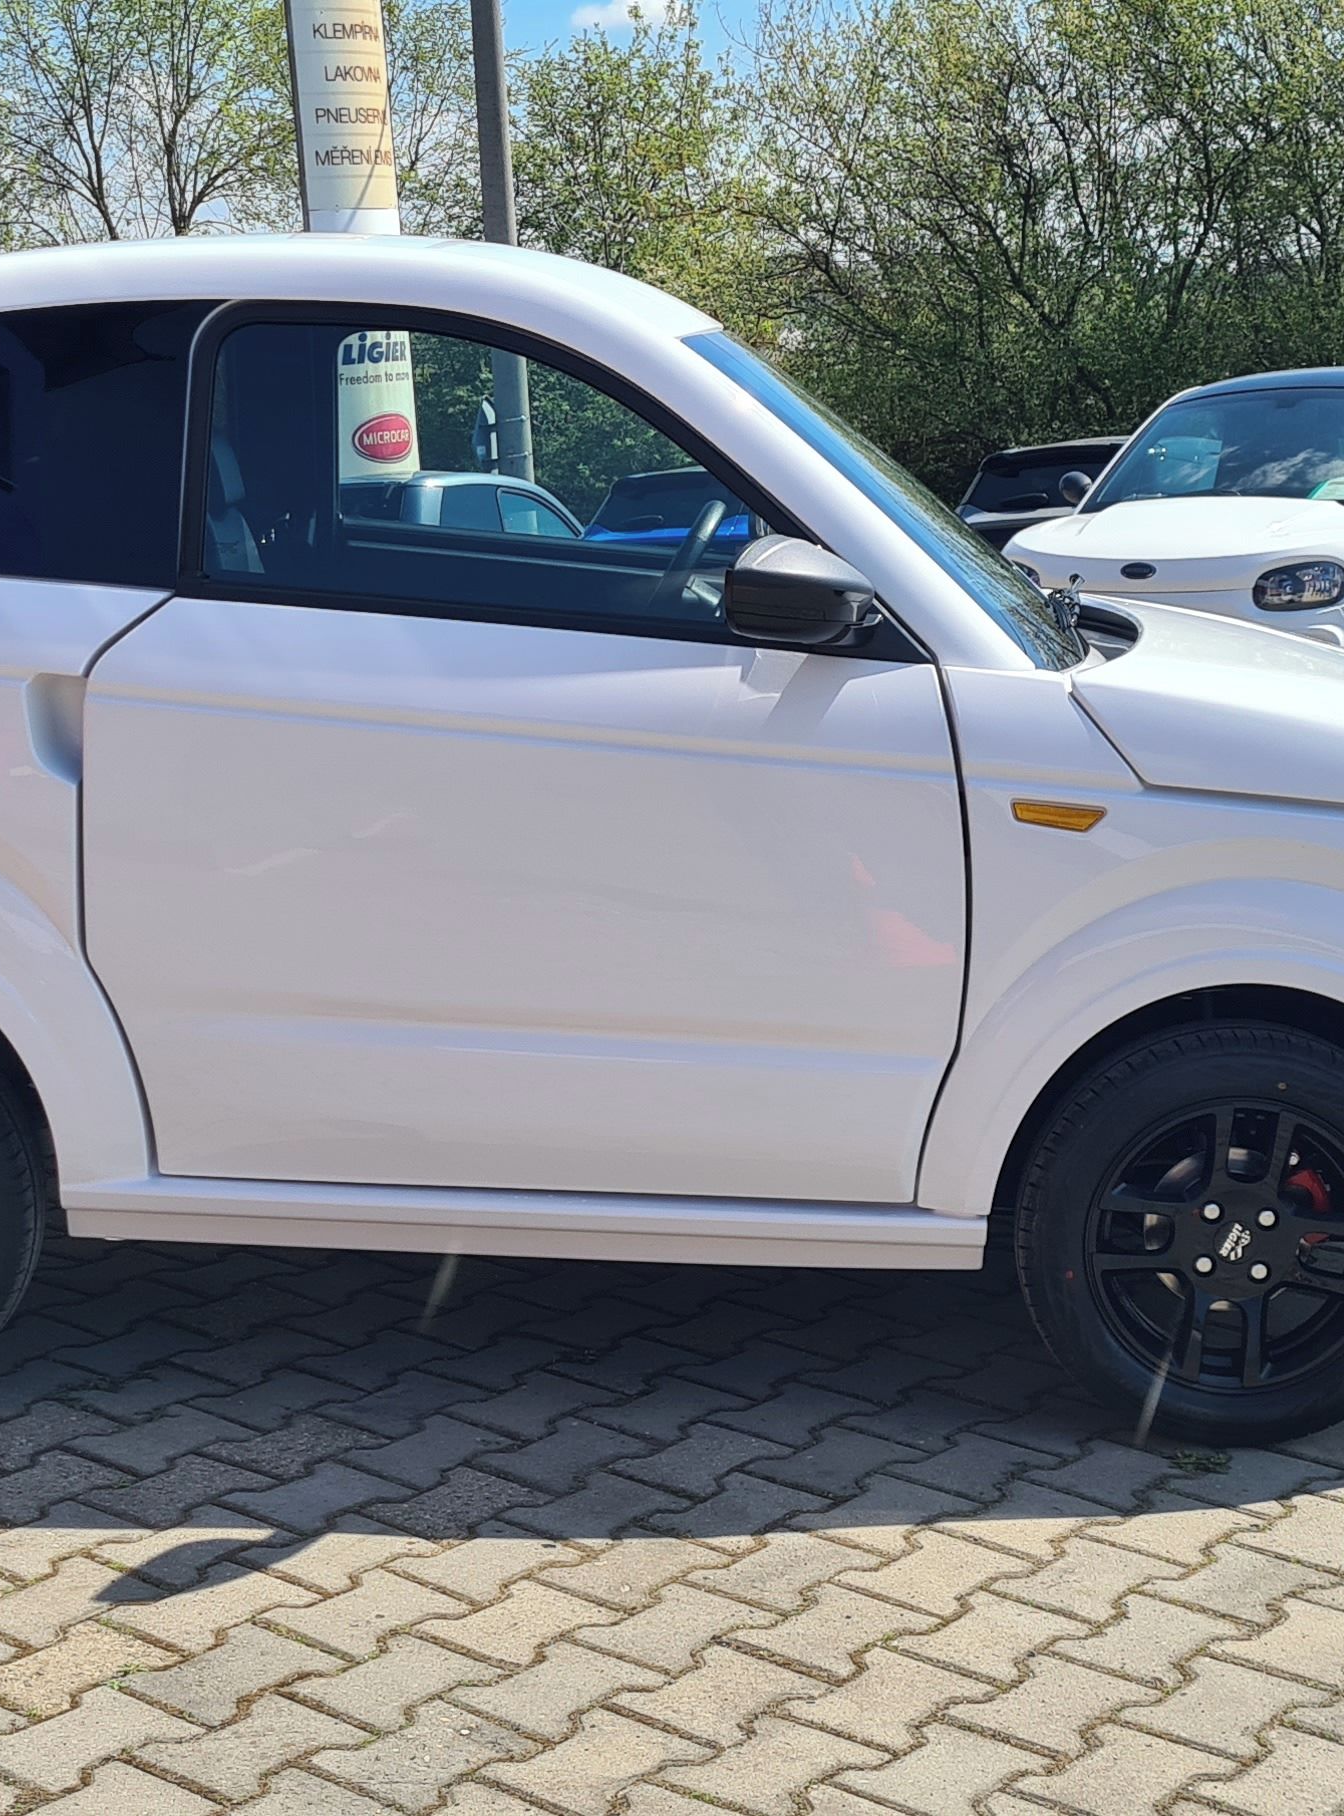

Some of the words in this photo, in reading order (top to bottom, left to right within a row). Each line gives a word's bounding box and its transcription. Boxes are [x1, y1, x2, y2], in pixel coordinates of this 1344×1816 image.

[324, 65, 381, 83] LAKOVNA
[315, 144, 372, 167] MĚŘENÍ
[339, 370, 383, 386] Freedom
[384, 371, 394, 383] to
[362, 429, 410, 446] MICROCAR
